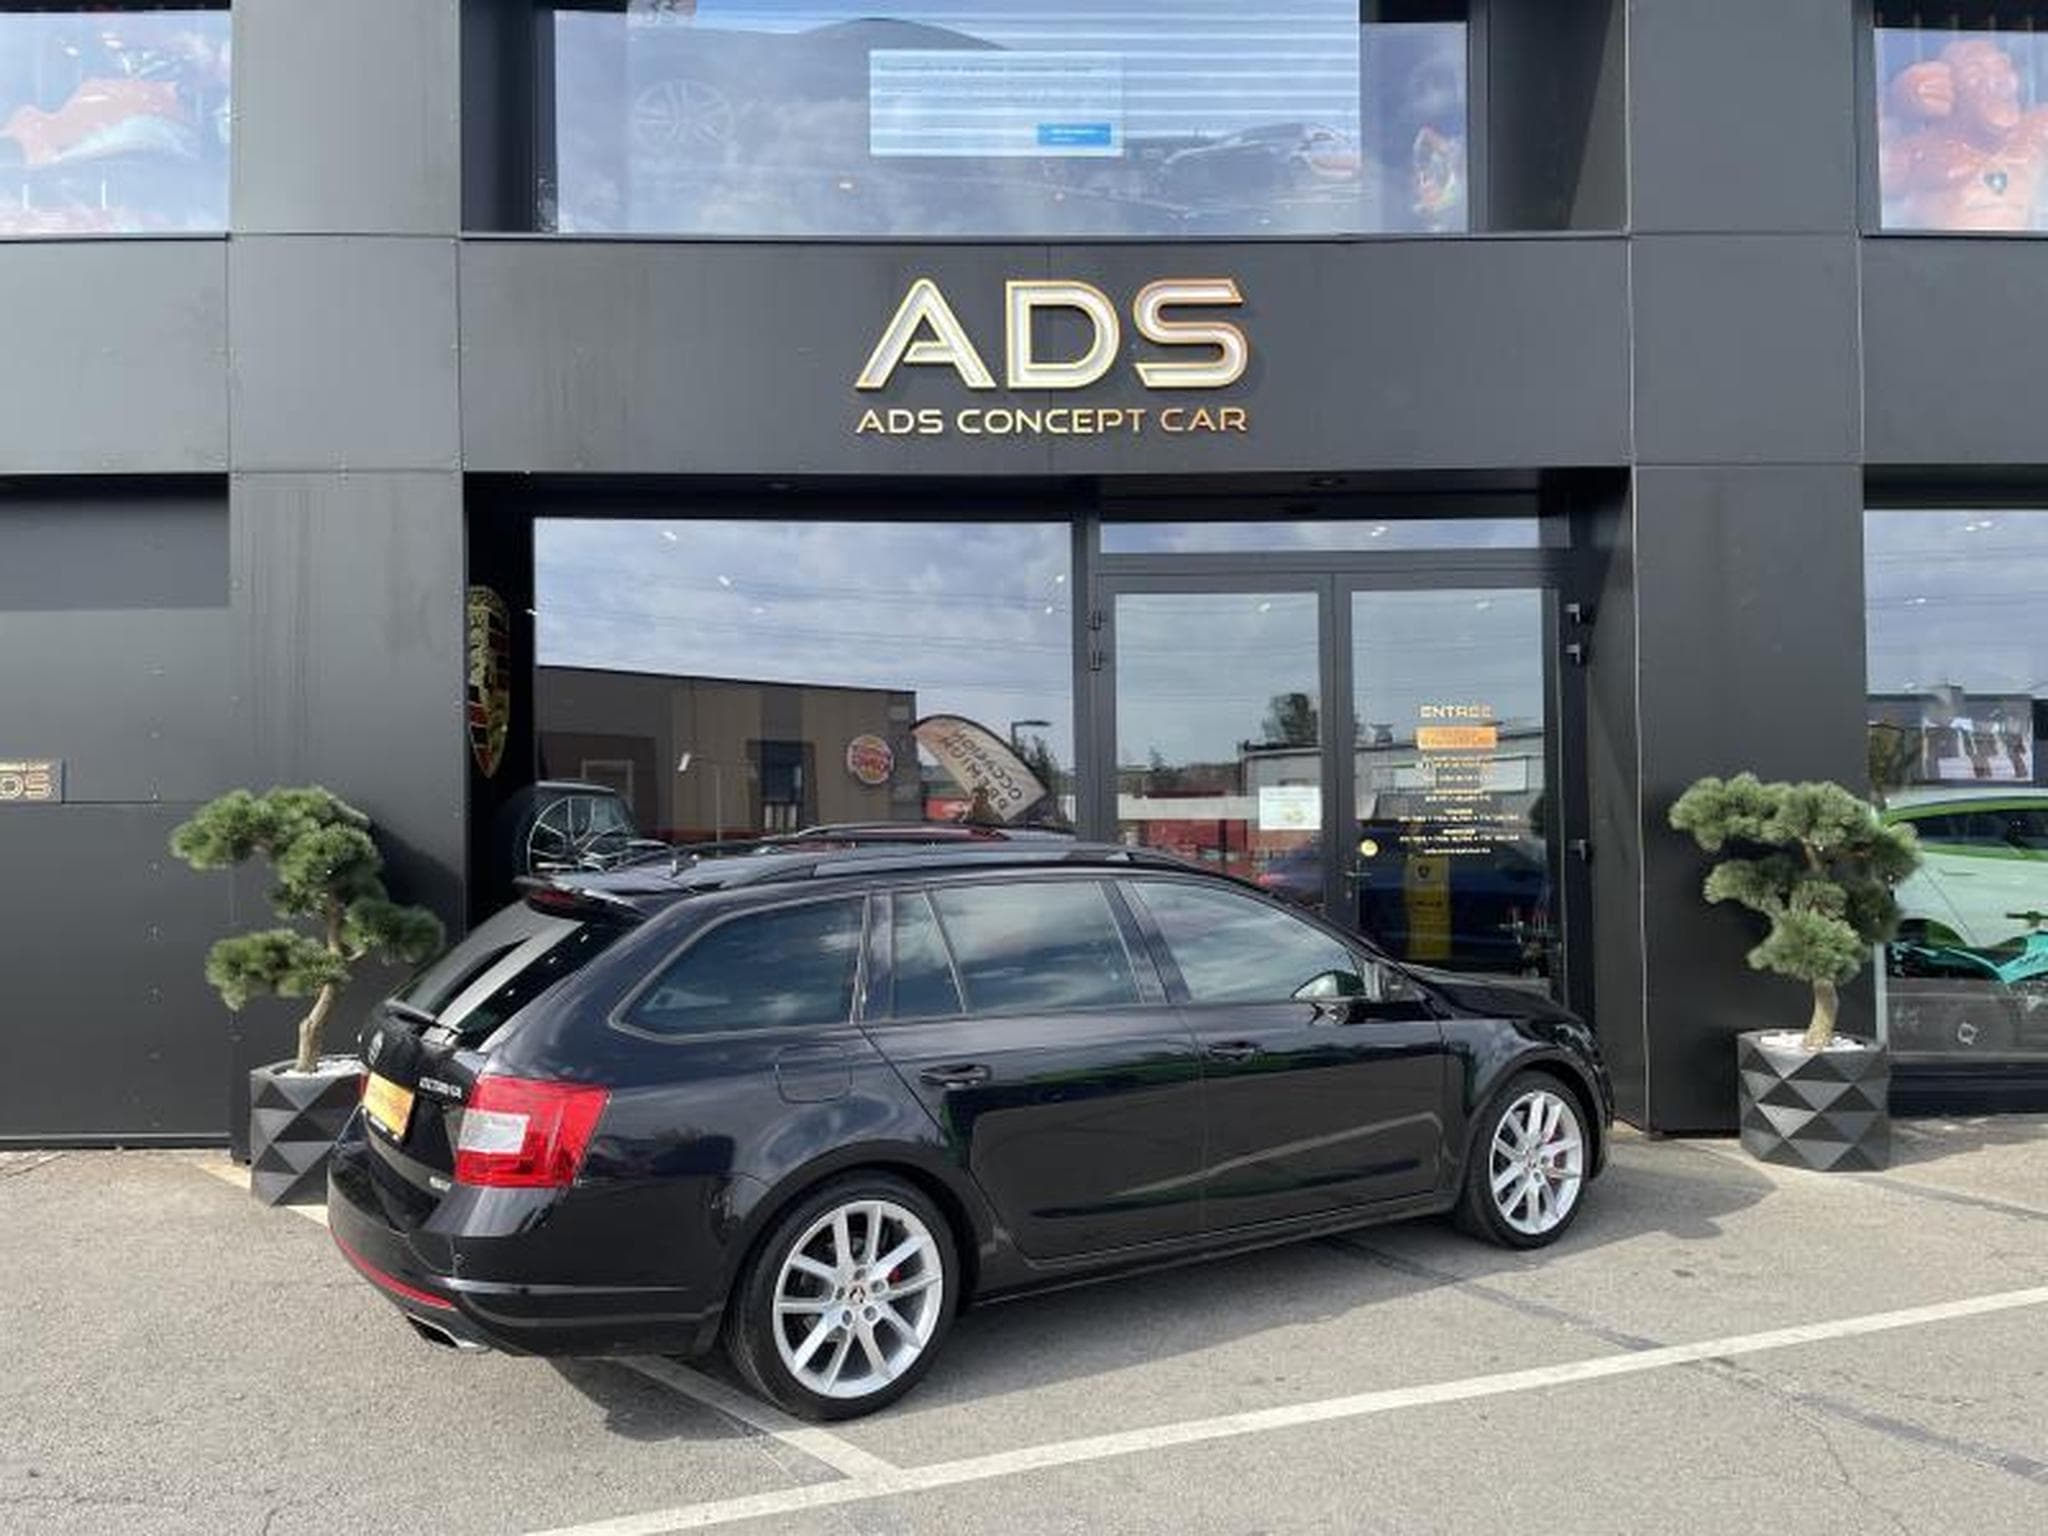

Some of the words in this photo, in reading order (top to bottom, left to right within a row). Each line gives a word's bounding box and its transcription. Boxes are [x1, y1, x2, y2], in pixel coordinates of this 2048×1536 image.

[855, 277, 1249, 389] ADS
[855, 408, 944, 434] ADS
[956, 408, 1146, 434] CONCEPT
[1160, 407, 1248, 432] CAR
